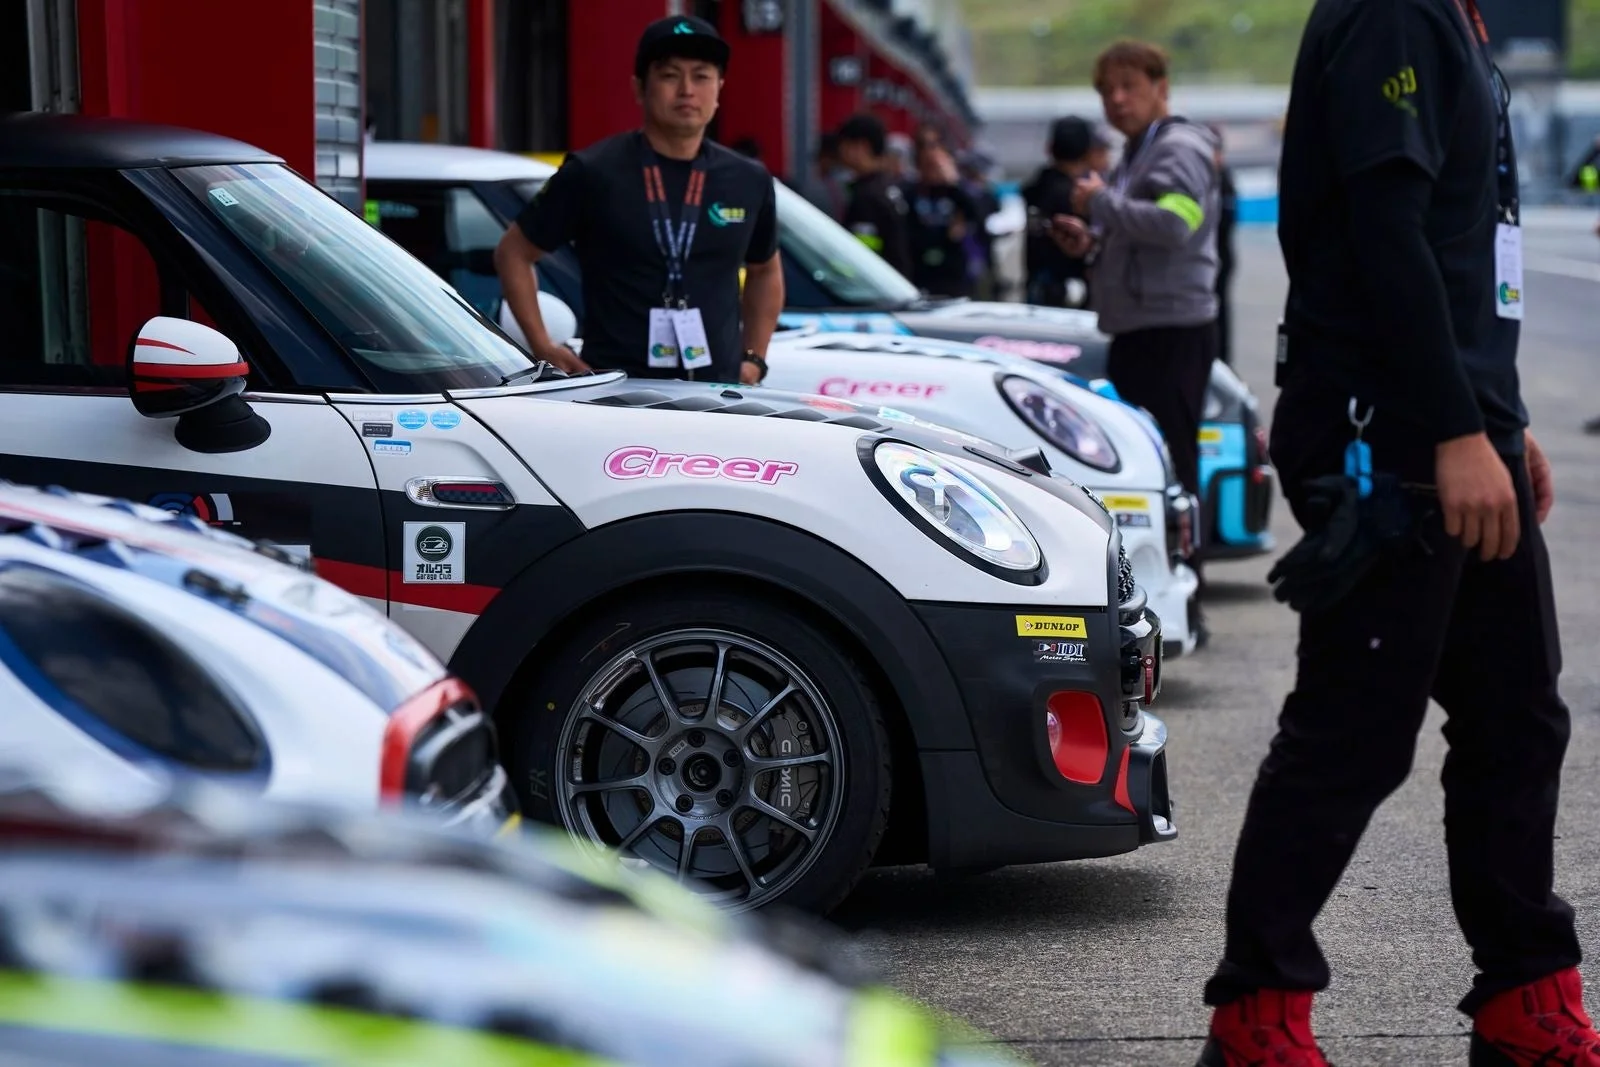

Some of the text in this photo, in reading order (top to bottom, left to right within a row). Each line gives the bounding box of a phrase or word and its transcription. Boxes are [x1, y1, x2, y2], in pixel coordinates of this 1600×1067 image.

[817, 375, 946, 399] Creer
[604, 446, 799, 485] Creer
[416, 563, 451, 573] オルクラ
[1034, 622, 1079, 631] DUNLOP
[1057, 642, 1085, 657] IDI
